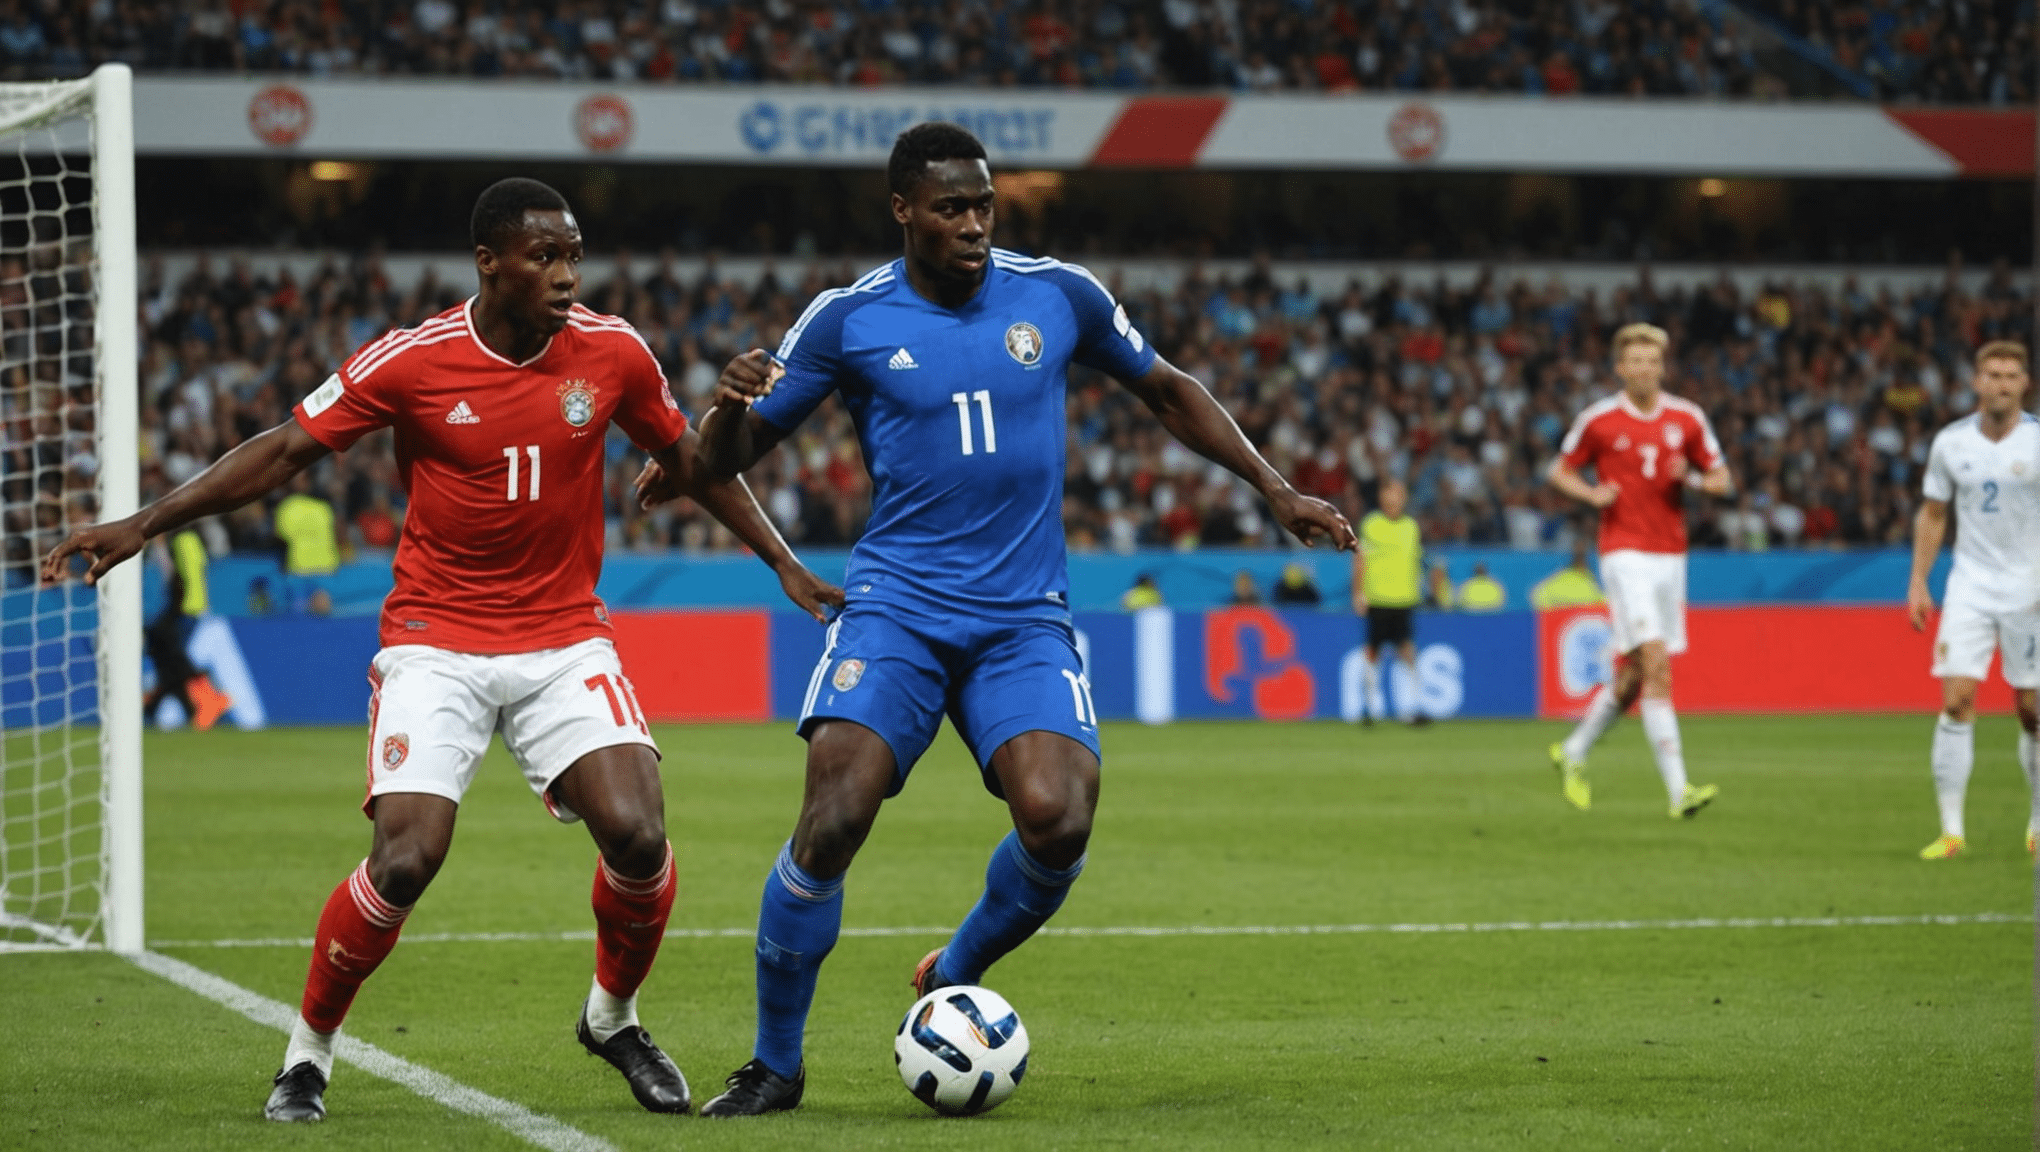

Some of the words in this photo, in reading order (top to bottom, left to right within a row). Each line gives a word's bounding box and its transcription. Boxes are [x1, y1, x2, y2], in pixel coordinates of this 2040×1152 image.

[952, 389, 996, 455] 11
[503, 445, 541, 501] 11
[1981, 480, 2000, 513] 2
